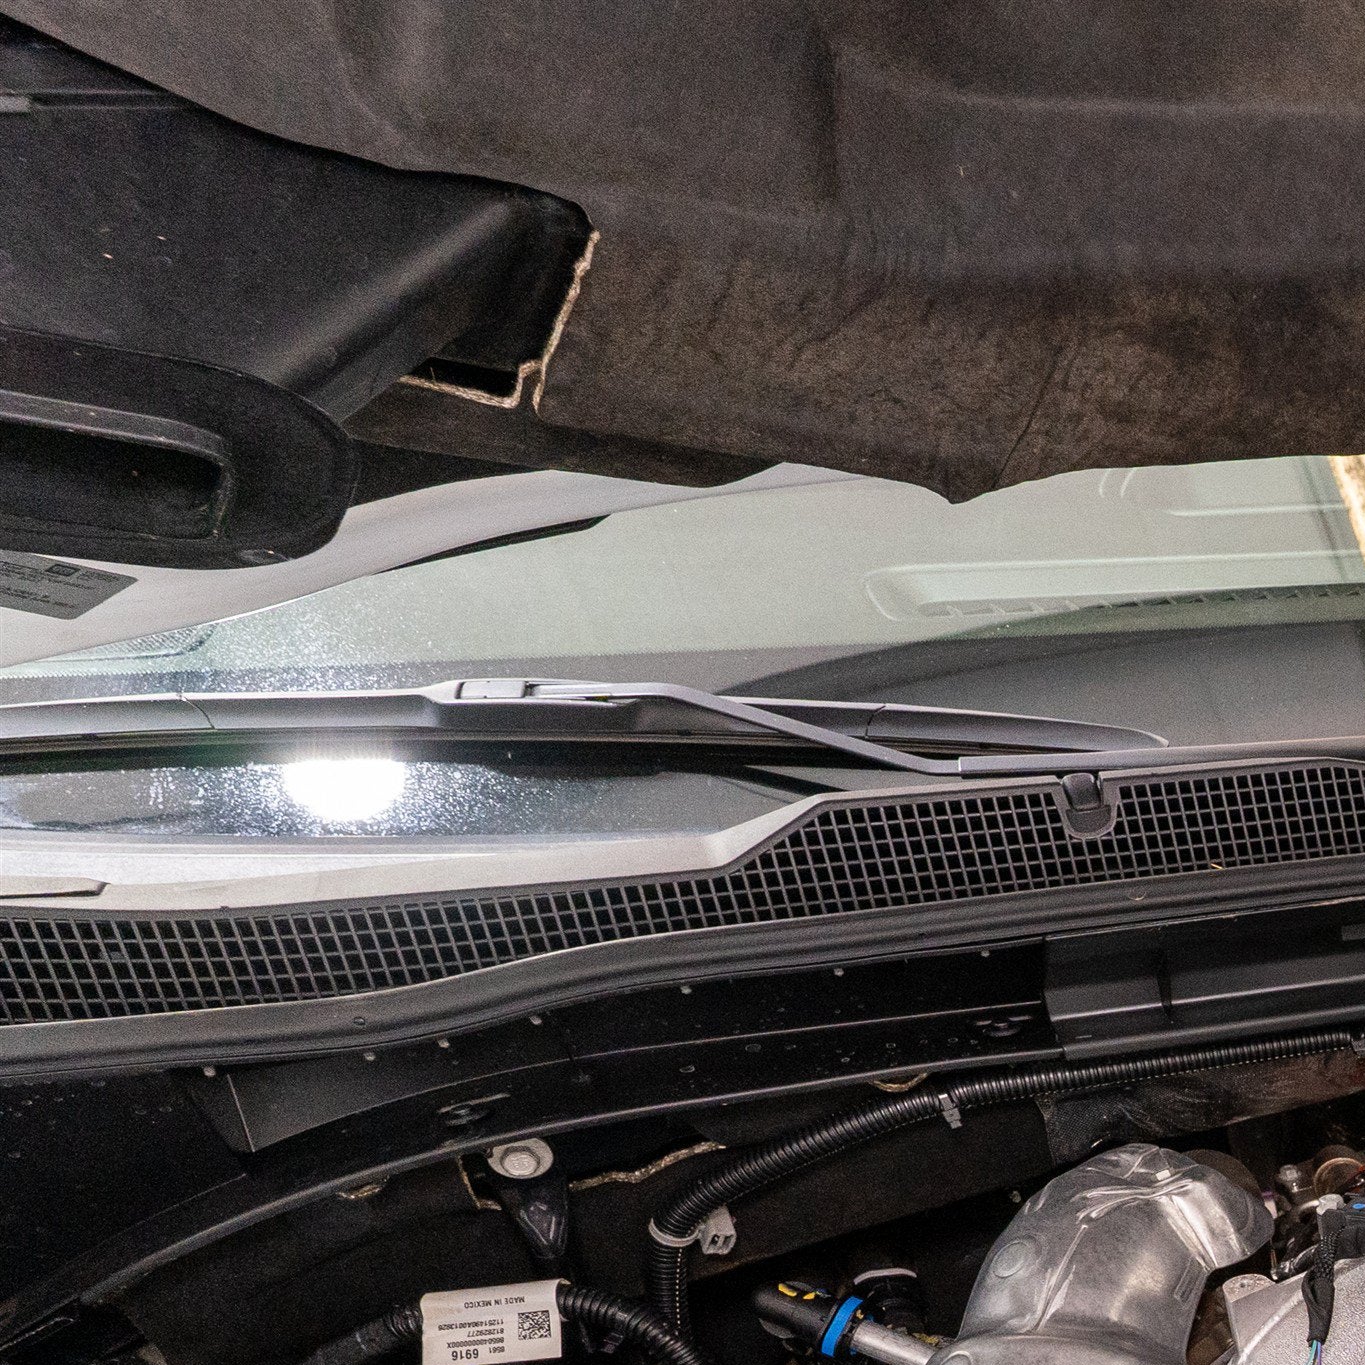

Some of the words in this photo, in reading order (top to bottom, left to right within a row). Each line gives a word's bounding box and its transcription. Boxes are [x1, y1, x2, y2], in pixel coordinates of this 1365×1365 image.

[463, 1299, 492, 1309] MEXICO
[494, 1298, 502, 1306] IN
[504, 1296, 525, 1306] MADE
[451, 1348, 479, 1361] 6916
